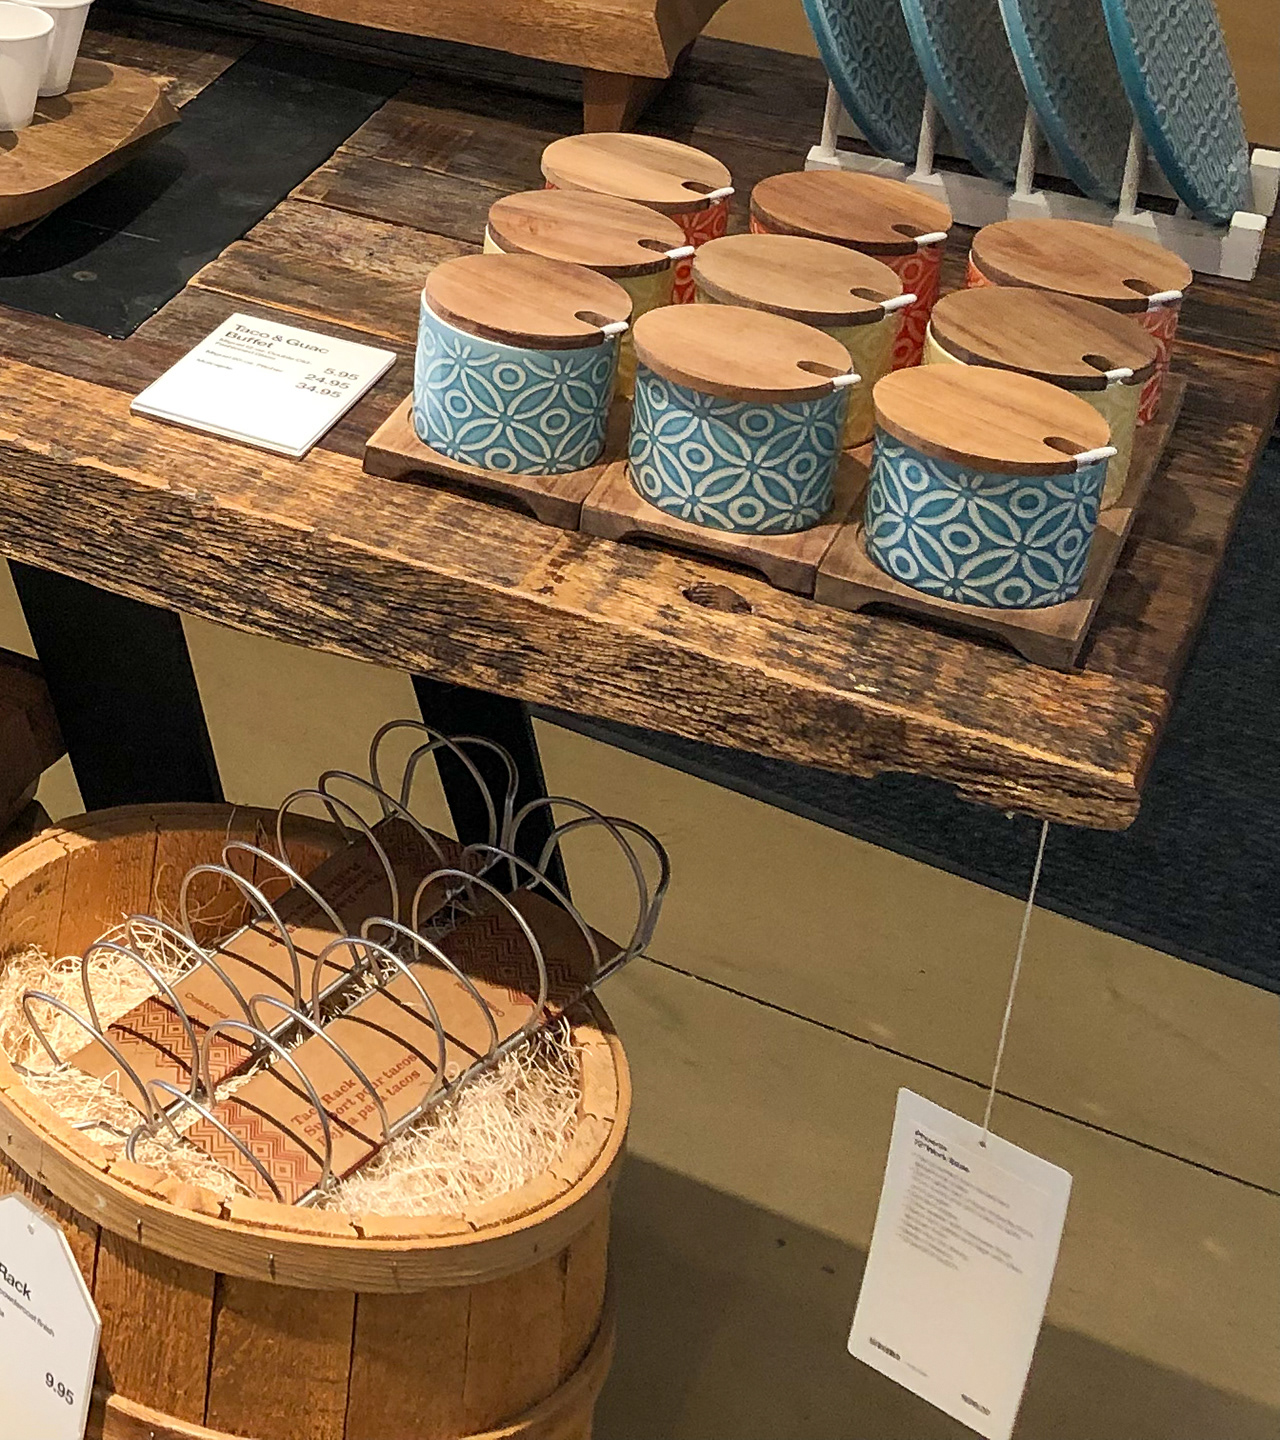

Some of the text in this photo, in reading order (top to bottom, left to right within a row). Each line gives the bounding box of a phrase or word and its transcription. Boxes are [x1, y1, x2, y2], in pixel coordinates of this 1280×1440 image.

[225, 331, 274, 348] Buffet
[235, 324, 330, 354] Taco & Guac
[304, 373, 351, 389] 24.95
[323, 367, 360, 381] 5.95
[295, 382, 342, 398] 34.95
[45, 1372, 75, 1406] 9.95
